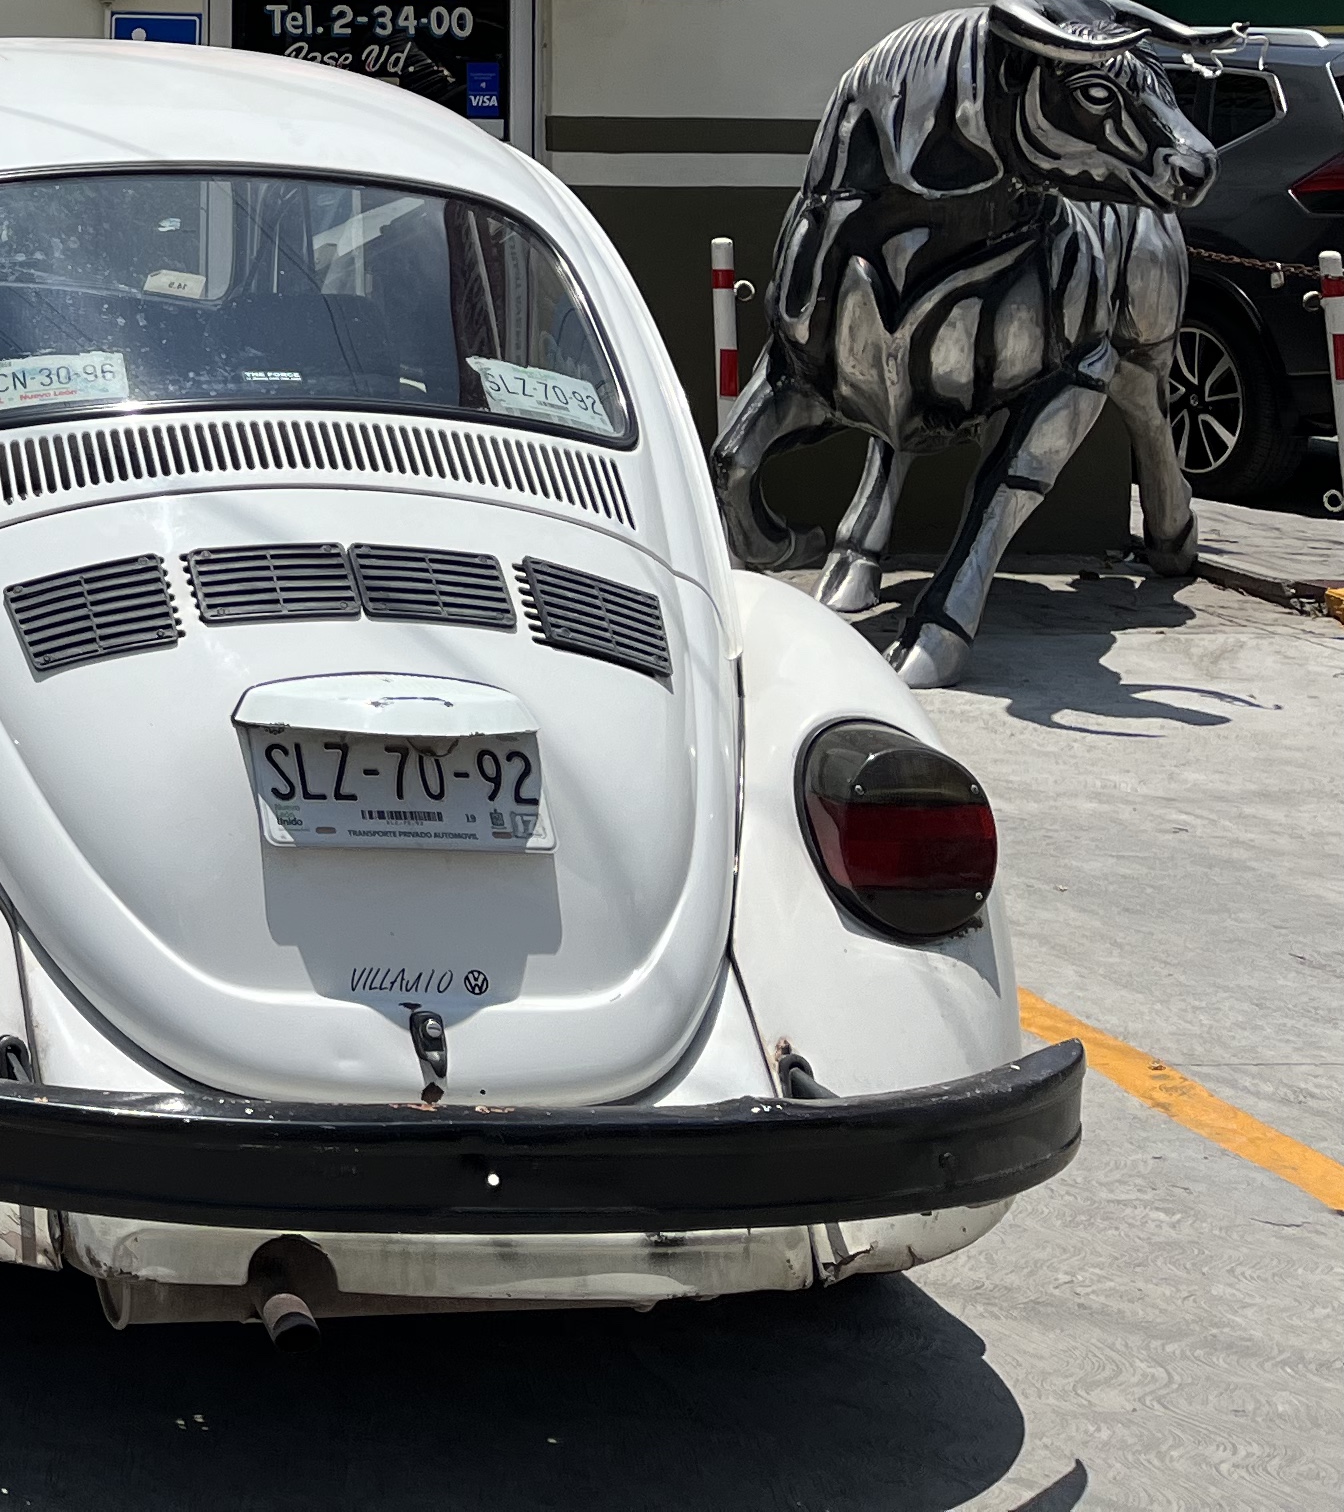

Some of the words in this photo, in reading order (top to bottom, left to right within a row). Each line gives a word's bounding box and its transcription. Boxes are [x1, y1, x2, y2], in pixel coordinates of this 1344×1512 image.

[266, 5, 324, 35] Tel.
[331, 5, 474, 37] 2-34-00
[469, 95, 498, 107] VISA
[485, 372, 604, 417] SLZ-70-92
[264, 742, 540, 806] SLZ-70-92
[347, 829, 397, 838] TRANSPORTE
[399, 830, 432, 839] PRIVADO
